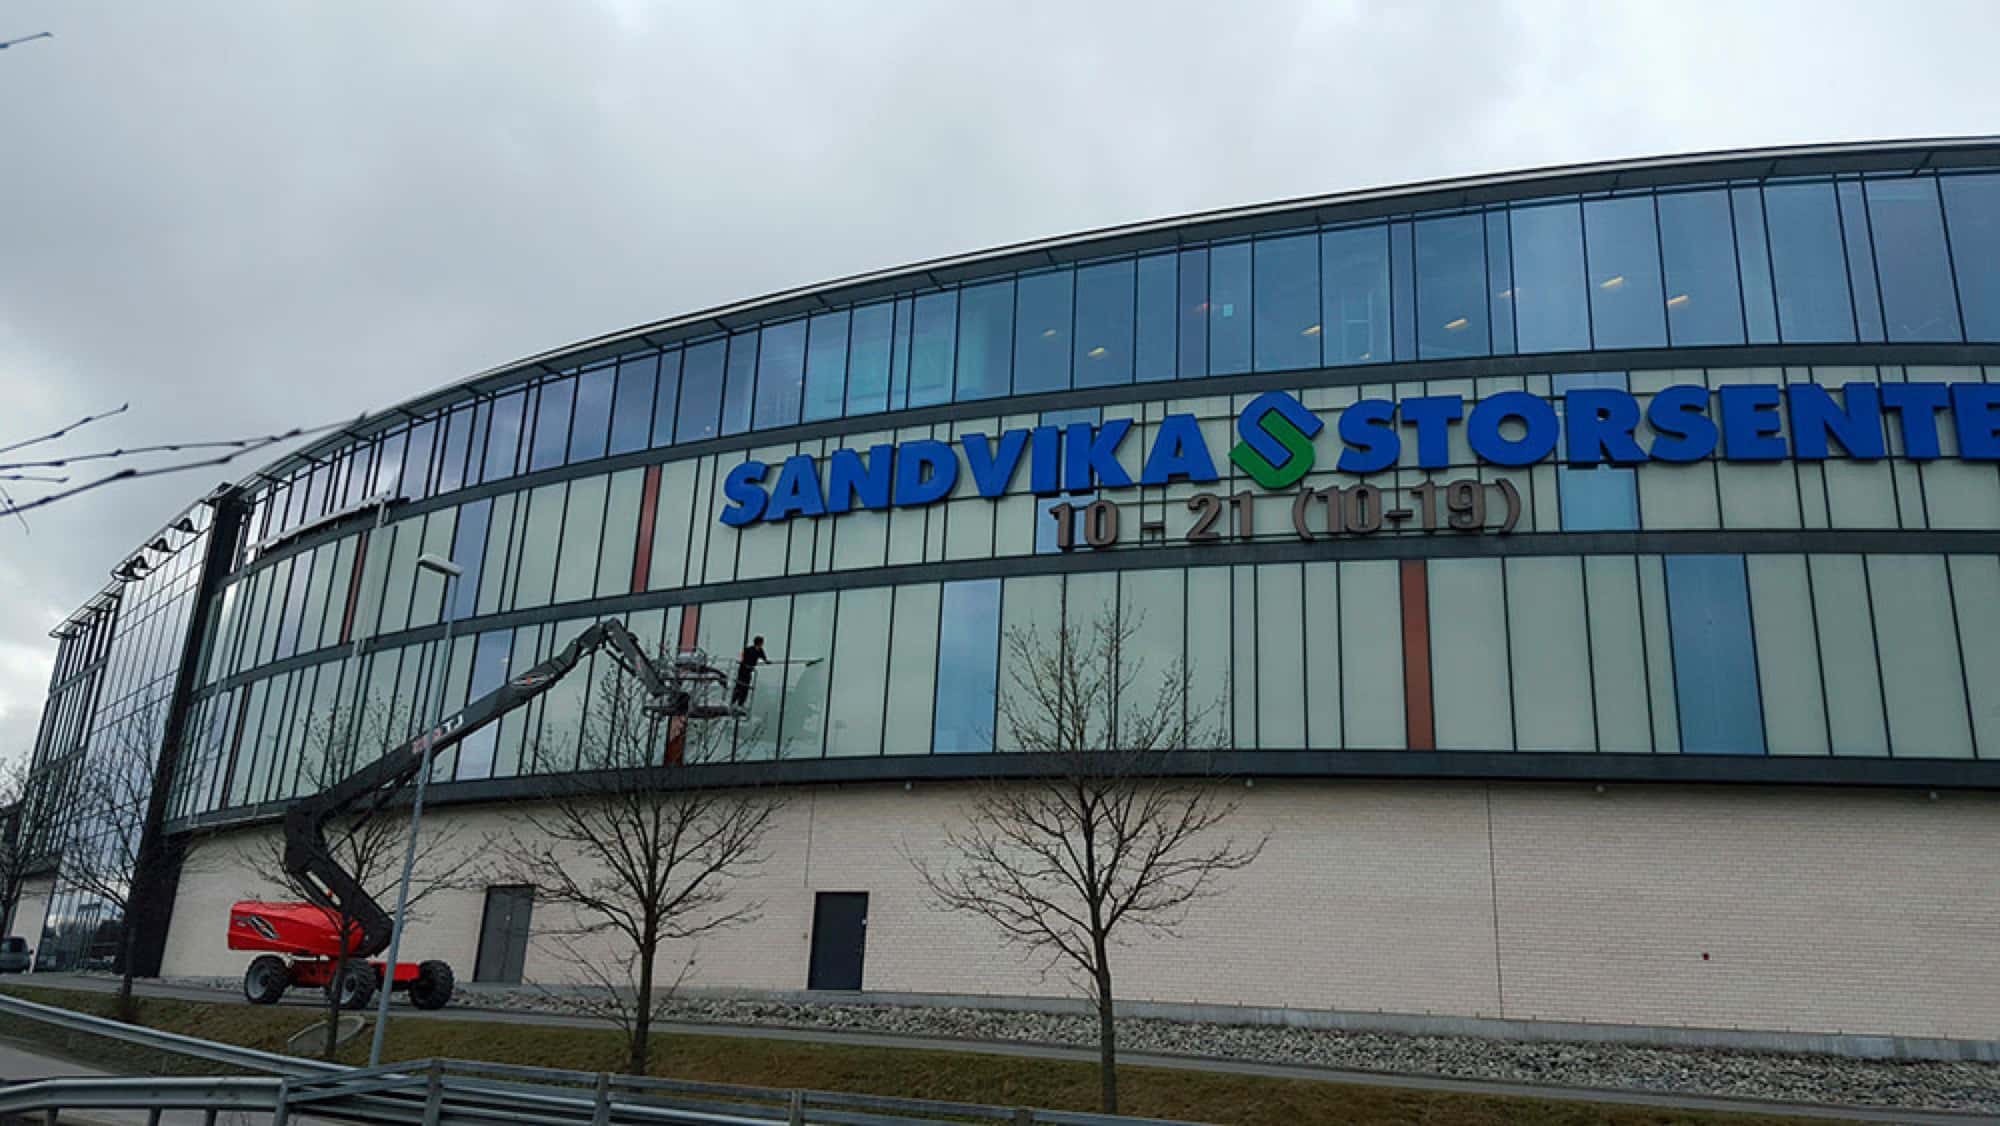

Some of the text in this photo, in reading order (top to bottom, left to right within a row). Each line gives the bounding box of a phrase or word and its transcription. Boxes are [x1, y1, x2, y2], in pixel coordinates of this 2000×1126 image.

[720, 414, 1218, 527] SANDVIKA
[1050, 500, 1119, 549] 10
[1187, 490, 1254, 542] 21
[1292, 477, 1521, 541] (10-19)
